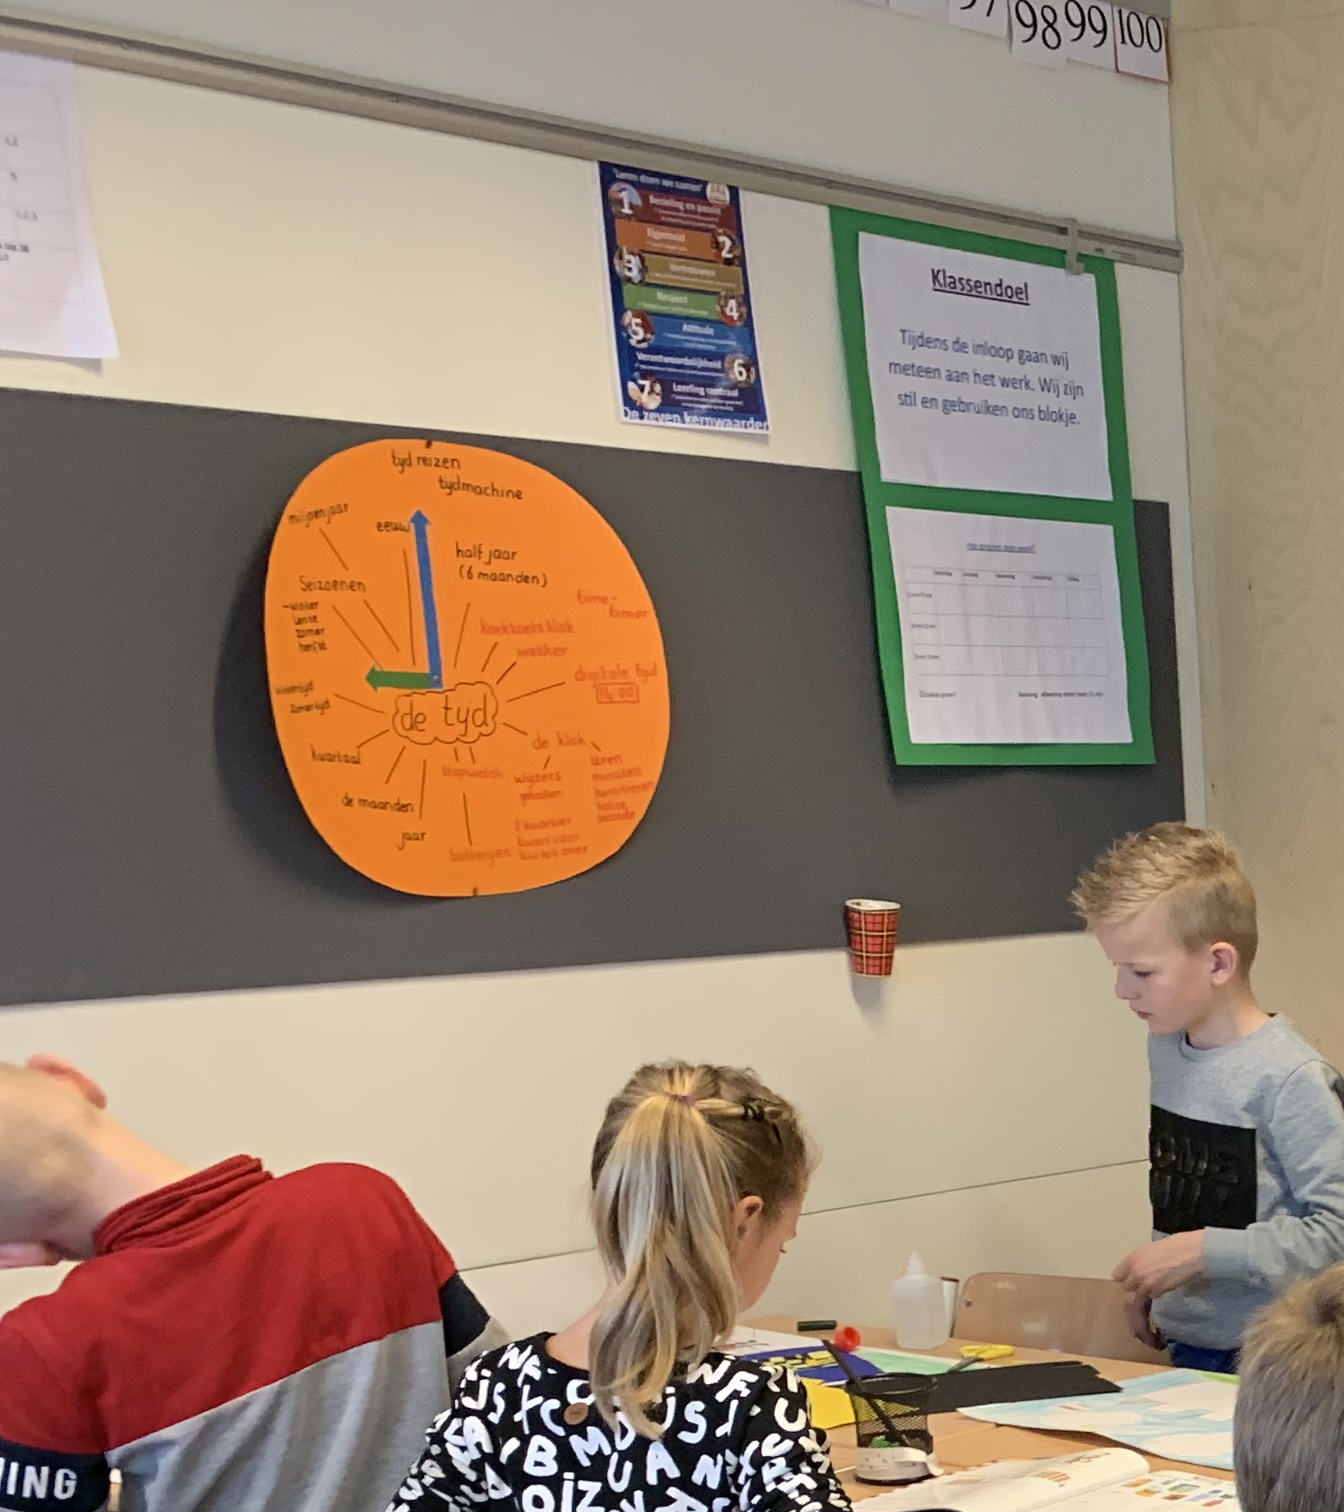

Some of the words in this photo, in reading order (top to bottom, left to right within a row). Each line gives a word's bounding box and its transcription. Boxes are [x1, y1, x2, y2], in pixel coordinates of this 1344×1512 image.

[1015, 0, 1062, 50] 98
[1064, 0, 1108, 48] 99
[1119, 8, 1164, 53] 100
[717, 235, 734, 259] 2
[930, 268, 1029, 302] Klassendoel
[725, 299, 740, 321] 4
[628, 317, 646, 341] 5
[899, 328, 949, 352] Tijdens
[951, 337, 969, 354] de
[972, 342, 1014, 362] inloop
[1017, 348, 1048, 366] gaan
[1050, 352, 1069, 371] wij
[733, 359, 748, 381] 6
[888, 361, 943, 379] meteen
[945, 367, 970, 383] aan
[973, 368, 996, 387] het
[998, 374, 1035, 392] werk.
[1038, 377, 1060, 398] Wij
[1063, 381, 1084, 400] zijn
[897, 391, 916, 407] stil
[920, 396, 938, 410] en
[941, 397, 1008, 417] gebruiken
[1012, 405, 1035, 421] ons
[1037, 405, 1081, 428] blokje.
[484, 545, 518, 566] jaar
[478, 570, 548, 588] maanden)
[532, 732, 549, 750] de
